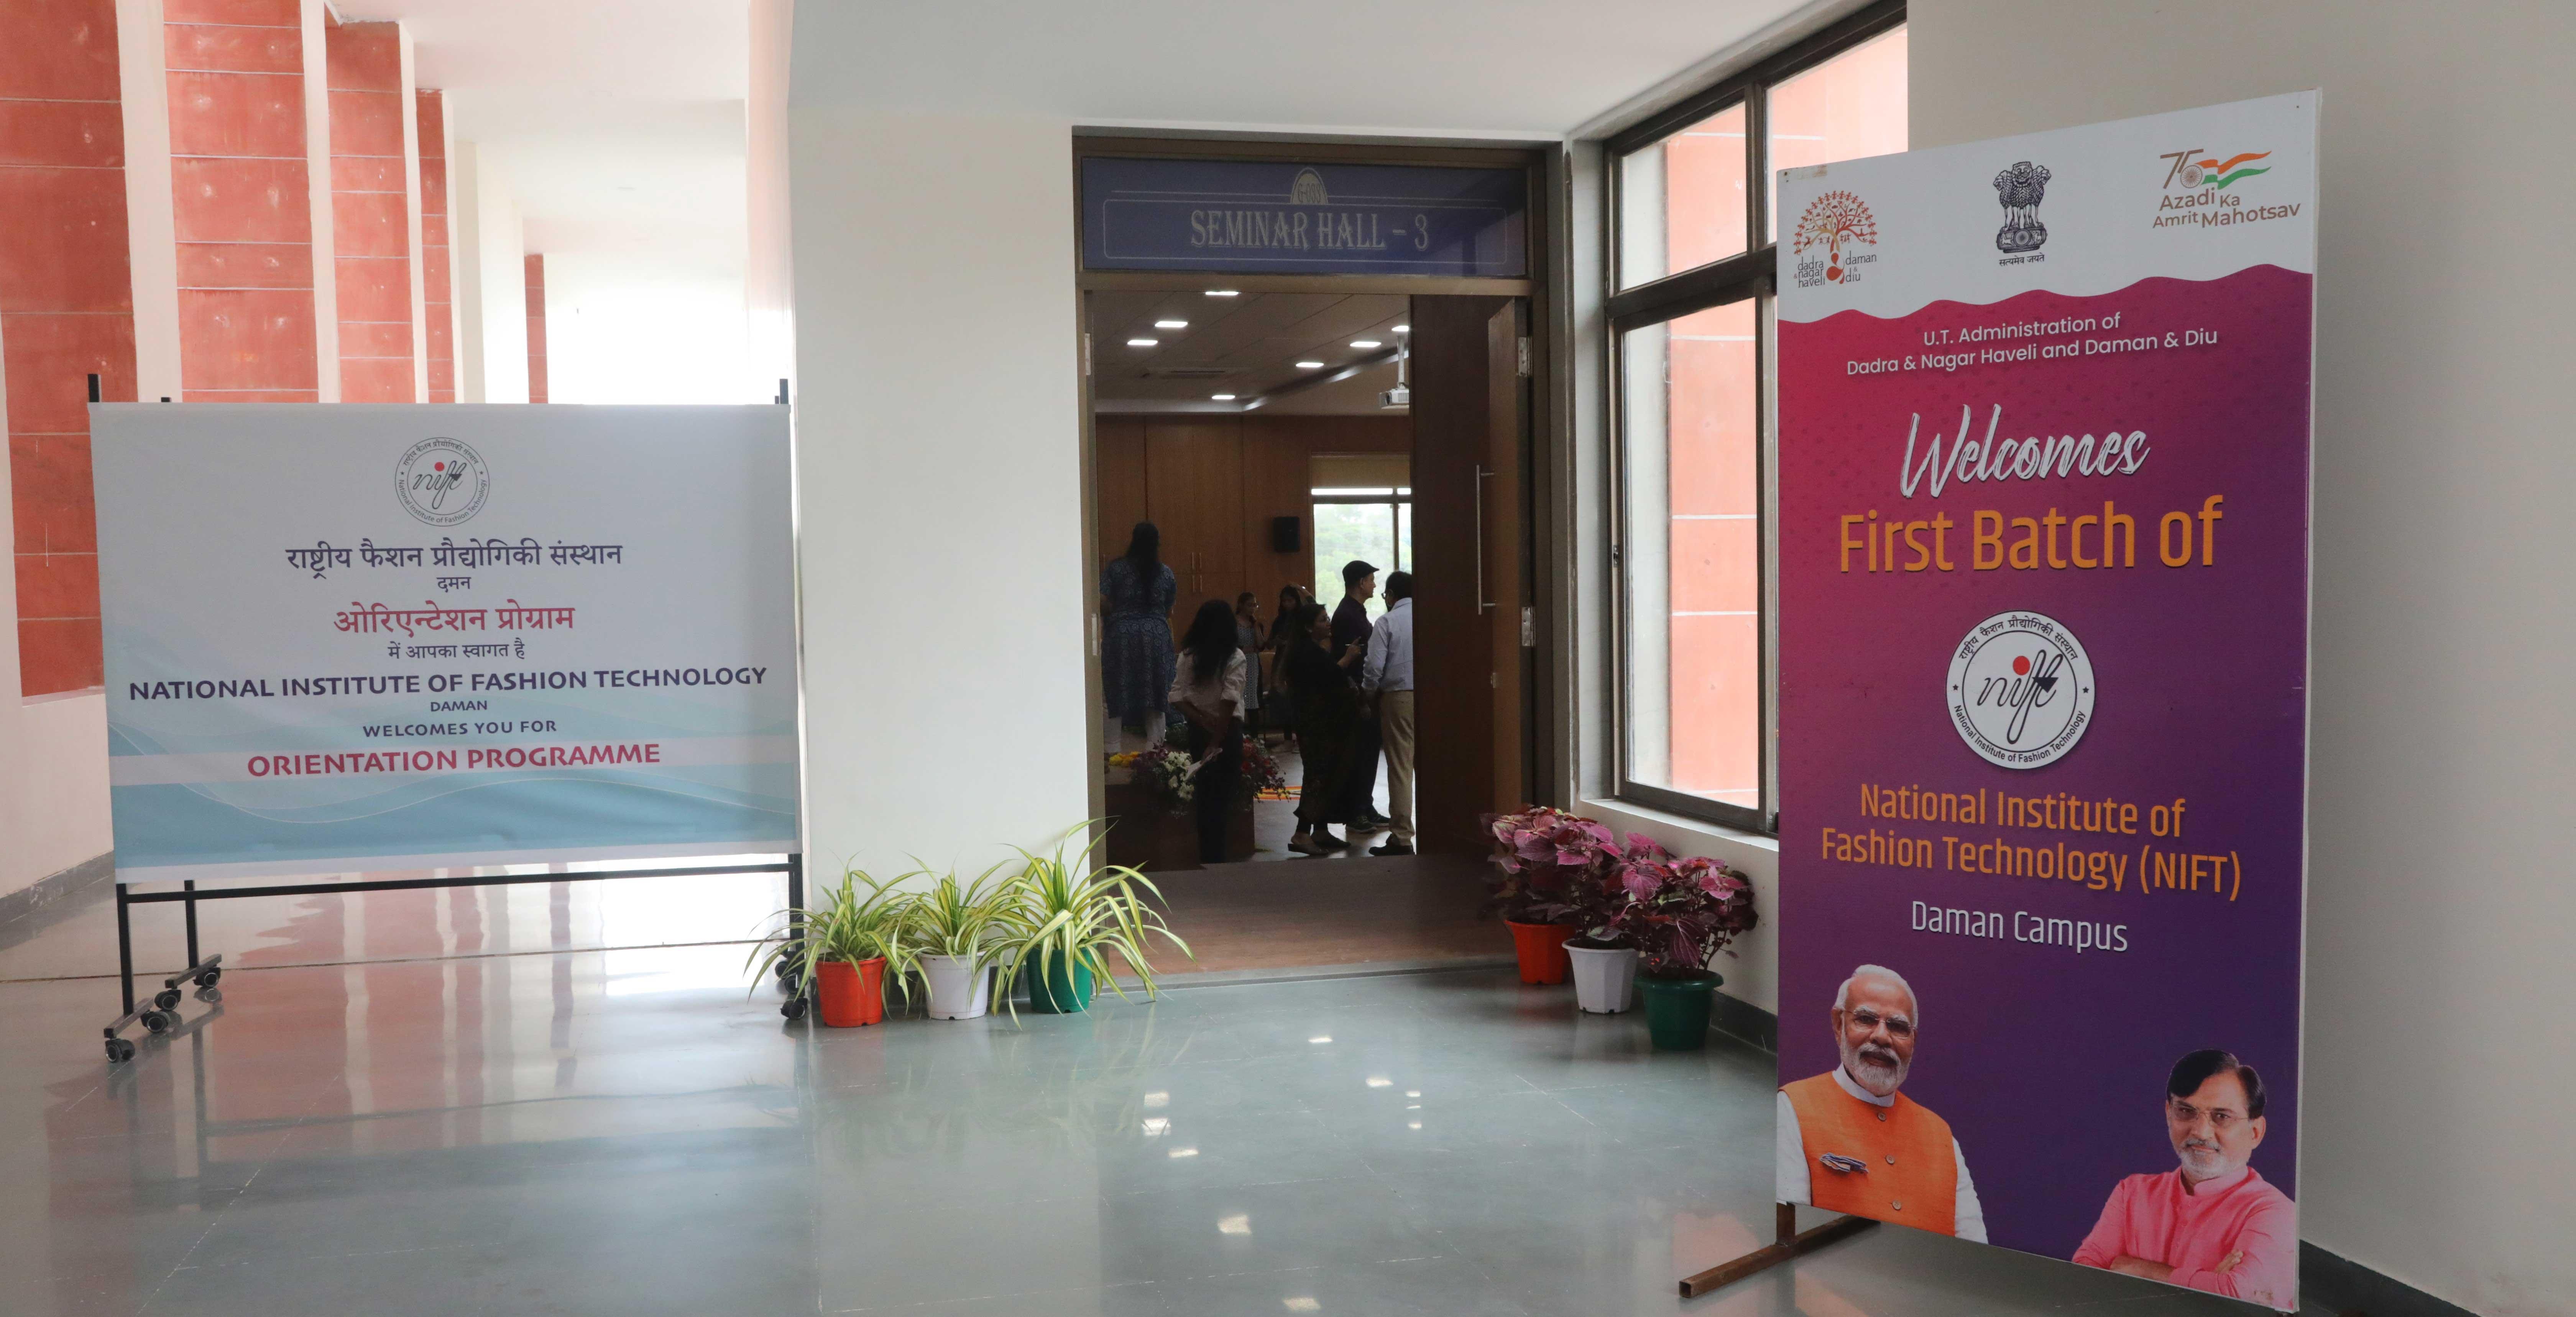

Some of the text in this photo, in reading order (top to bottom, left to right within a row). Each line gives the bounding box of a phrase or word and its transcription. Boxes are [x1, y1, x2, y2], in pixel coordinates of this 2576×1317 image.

[2159, 187, 2240, 211] Azadi Ka
[1190, 209, 1310, 252] SEMINAR
[1318, 212, 1387, 251] HALL
[1414, 213, 1429, 251] 3
[2152, 203, 2301, 229] Amrit Mahotsav
[1798, 255, 1824, 271] dadra
[1798, 268, 1824, 279] nagar
[1845, 250, 1877, 265] daman
[1999, 252, 2044, 266] सत्यमेव जयते
[1798, 276, 1825, 288] haveli
[1845, 268, 1860, 282] diu
[1924, 312, 2121, 345] U.T. Administration of
[1847, 327, 2217, 375] Dadra & Nagar Haveli and Daman & Diu
[1900, 403, 2150, 498] Welcomes
[399, 480, 411, 505] National
[411, 504, 435, 522] Institute
[445, 511, 469, 523] Fashion
[467, 479, 487, 513] Technology
[1841, 494, 2223, 572] First Batch of
[286, 537, 623, 579] राष्ट्रीय फैशन प्रौद्योगिकी संस्थान
[437, 577, 471, 592] दमन
[334, 599, 575, 637] ओरिएन्टेशन प्रोग्राम
[388, 638, 525, 659] में आपका स्वागत है
[1959, 615, 2078, 660] राष्ट्रीय फैशन प्रौद्योगिकी संस्थान
[130, 667, 767, 700] NATIONAL INSTITUTE OF FASHION TECHNOLOGY
[430, 700, 488, 712] DAMAN
[363, 720, 557, 737] WELCOMES YOU FOR
[1954, 705, 2086, 763] National Institute of Fashion Technology
[248, 744, 660, 777] ORIENTATION PROGRAMME
[1860, 784, 2185, 837] National Institute of
[1822, 827, 2241, 901] Fashion Technology (NIFT)
[1912, 901, 2128, 954] Daman Campus
